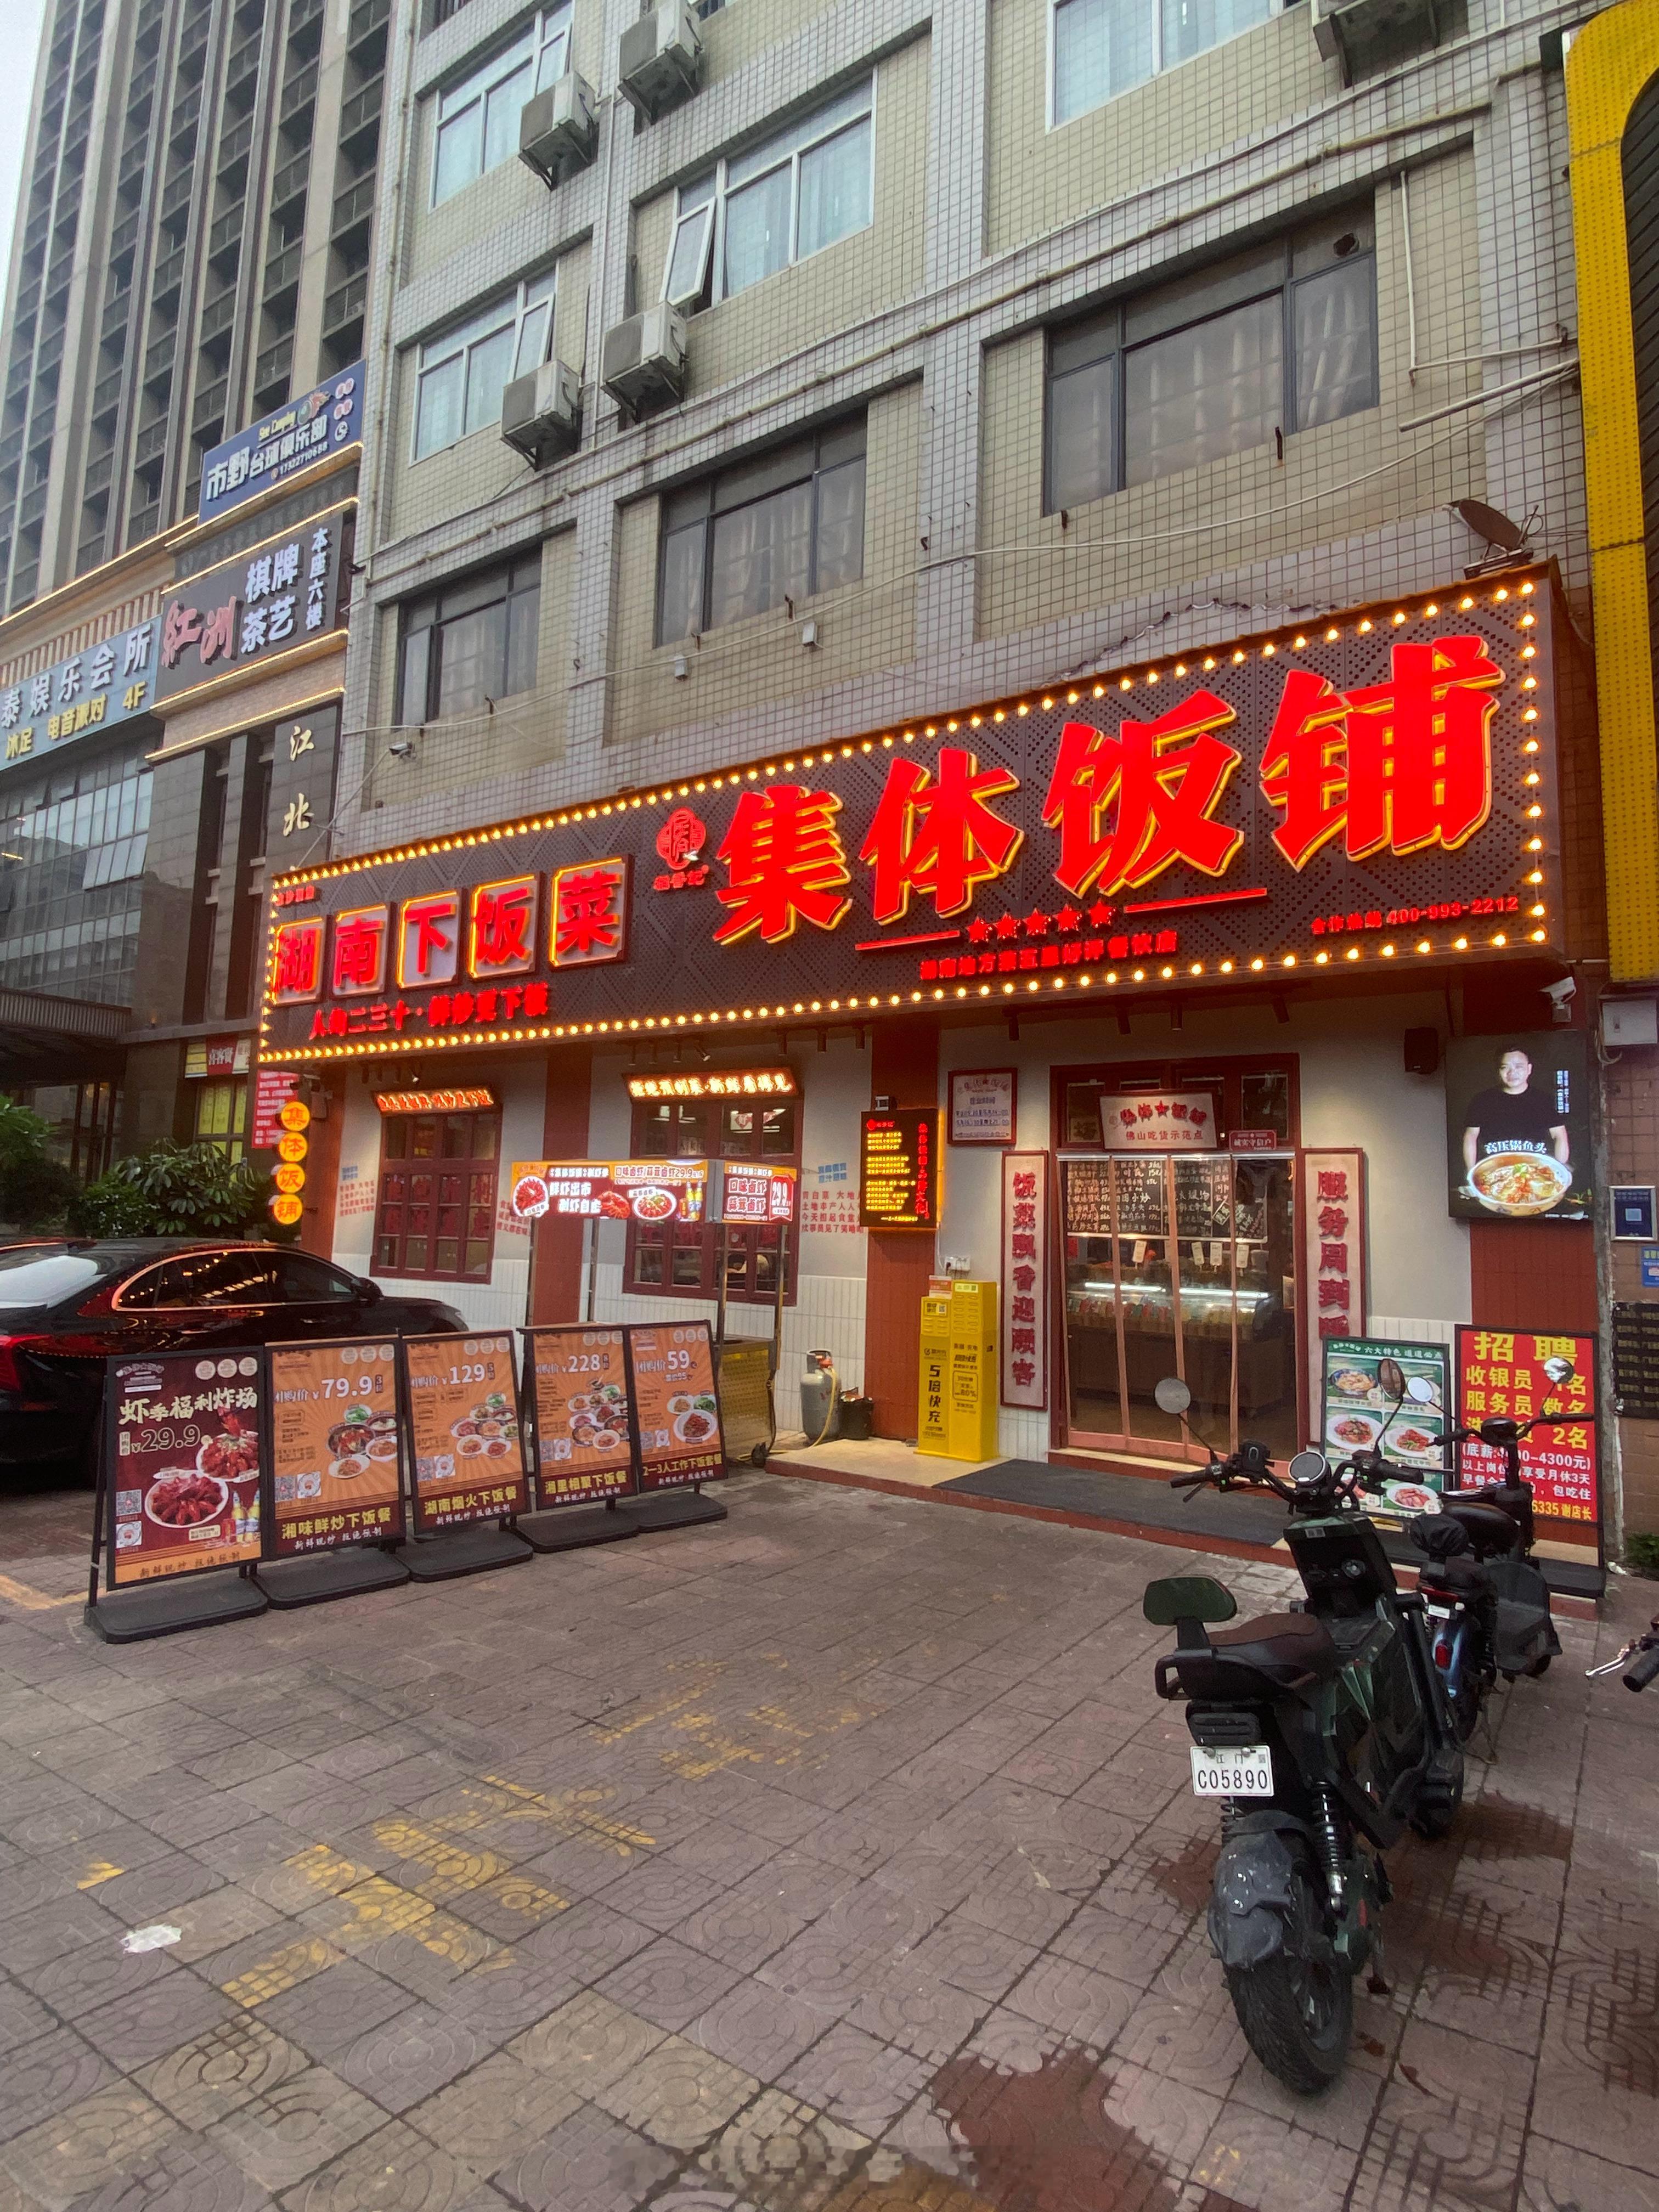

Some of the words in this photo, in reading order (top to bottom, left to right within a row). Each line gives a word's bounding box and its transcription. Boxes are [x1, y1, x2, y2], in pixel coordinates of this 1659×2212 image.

[246, 544, 299, 603] 棋牌
[241, 595, 295, 653] 茶艺
[122, 681, 145, 709] 4F
[712, 635, 1505, 944] 集体饭铺
[1386, 896, 1518, 924] 400-993-2212
[274, 871, 620, 992] 湖南下饭菜
[1126, 1129, 1203, 1141] 佛山吃货示范点
[1483, 1139, 1547, 1154] 高压锅鱼头
[276, 1107, 304, 1219] 集体饭铺
[802, 1202, 860, 1211] 土地丰产人人
[837, 1190, 860, 1200] 大地
[1364, 1346, 1402, 1357] 六大特色
[1474, 1331, 1578, 1365] 招聘
[1465, 1364, 1533, 1391] 收银员
[119, 1386, 258, 1425] 虾季福利炸场
[928, 1364, 941, 1423] 5倍快充
[1465, 1390, 1534, 1417] 服务员
[1553, 1427, 1588, 1450] 2名
[281, 1506, 391, 1540] 湘味鲜炒下饭餐
[1216, 1753, 1244, 1764] 江门
[1198, 1769, 1268, 1789] C05890
